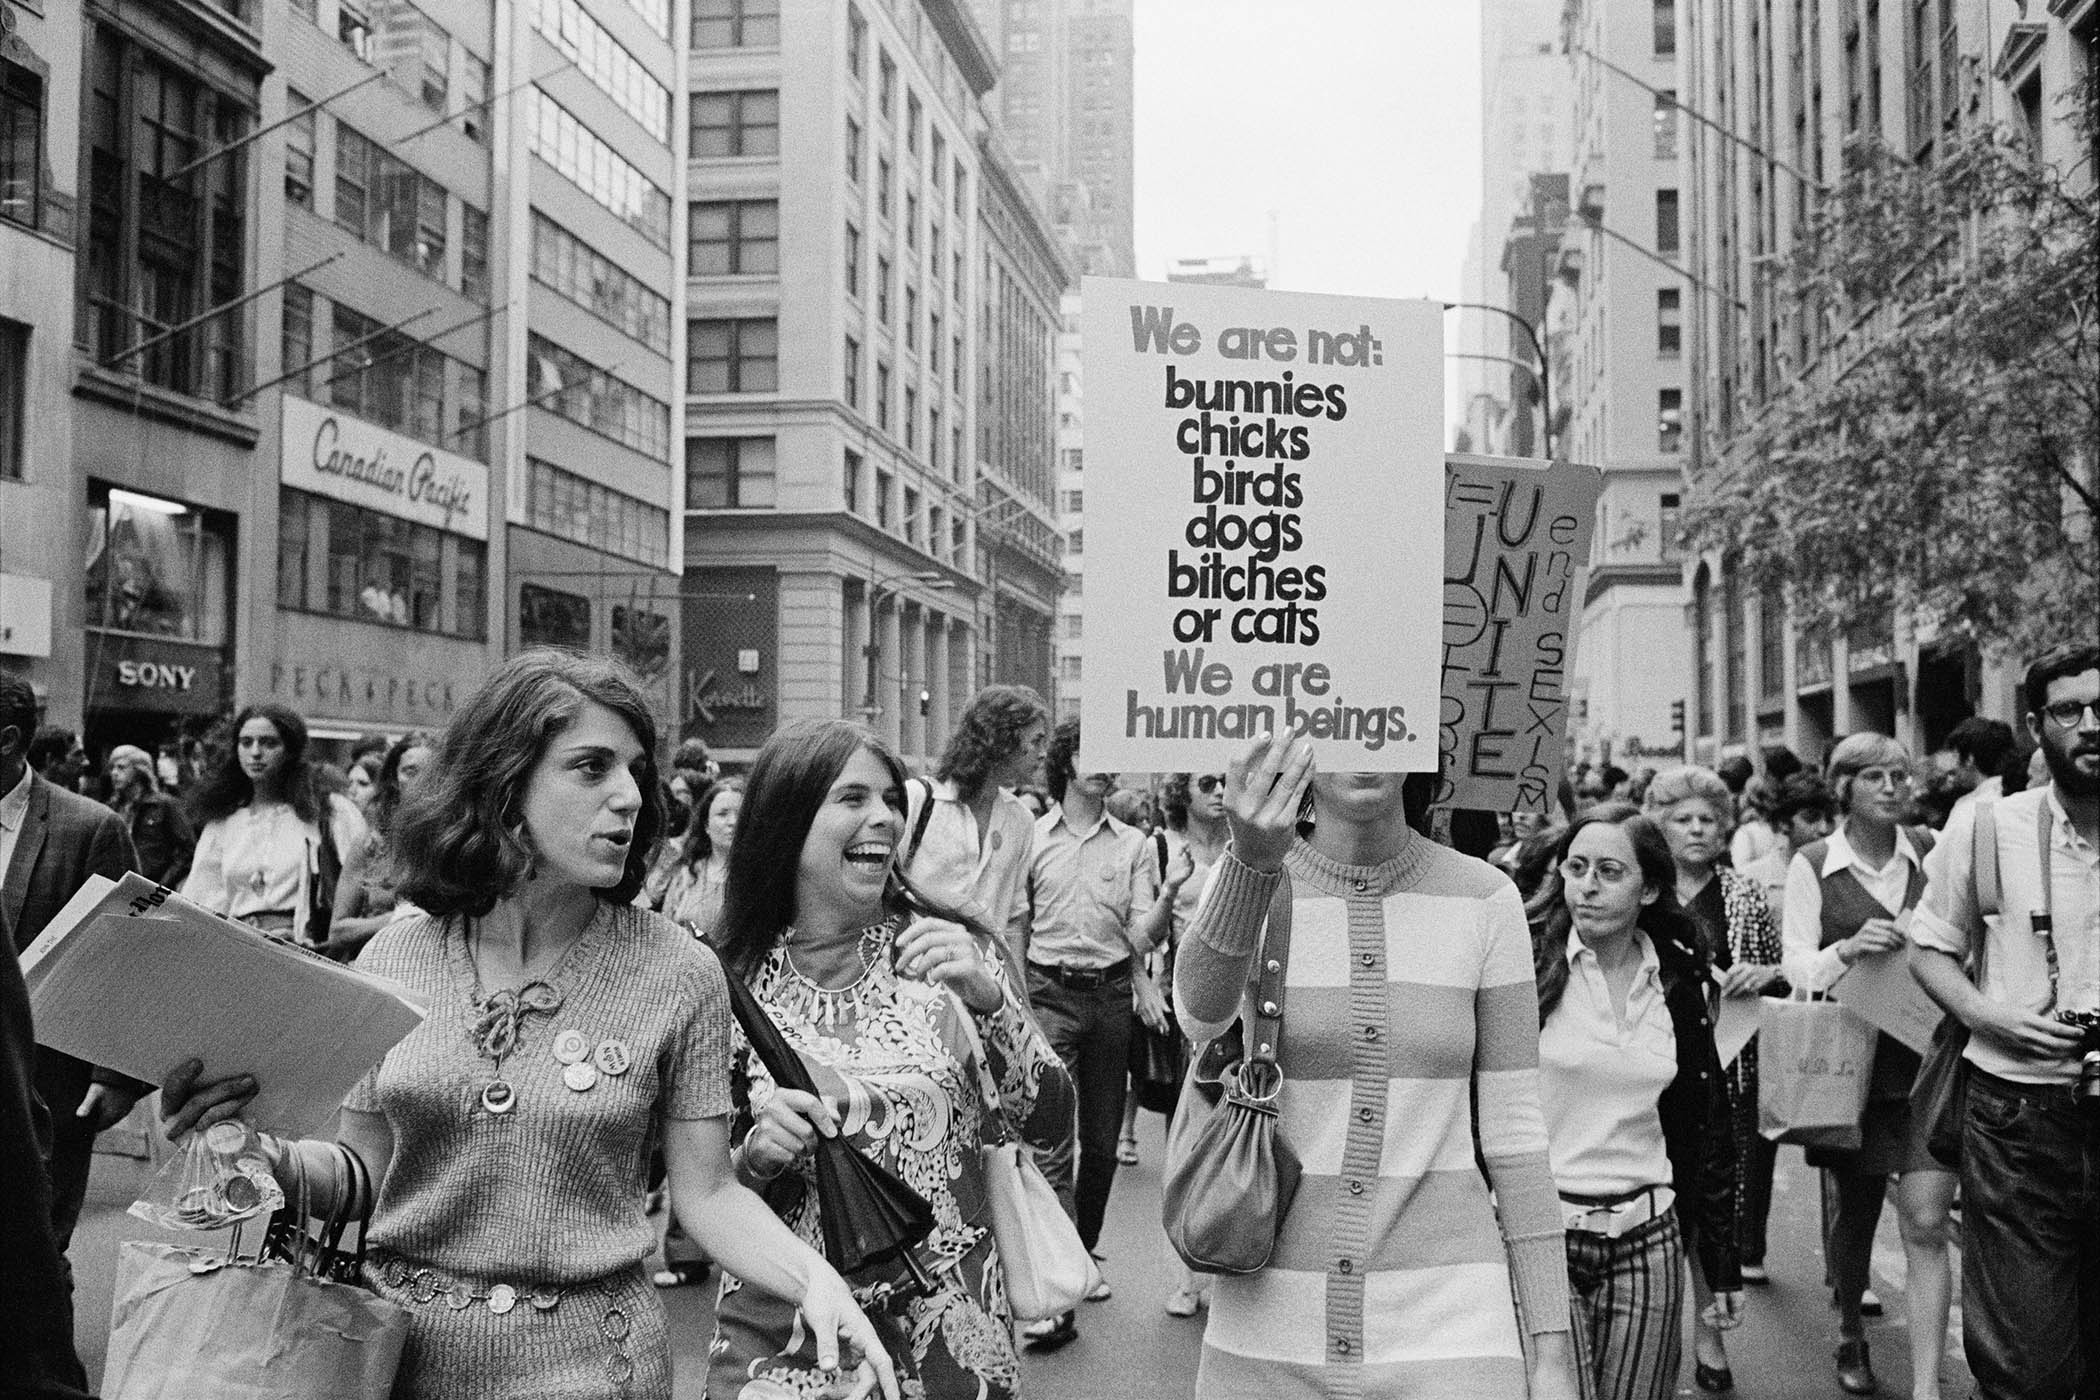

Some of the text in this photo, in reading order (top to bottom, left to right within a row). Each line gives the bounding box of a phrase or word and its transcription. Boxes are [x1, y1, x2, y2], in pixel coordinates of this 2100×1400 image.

[1130, 306, 1383, 367] We are not:
[1165, 365, 1347, 421] bunnies
[1176, 411, 1310, 461] chicks
[312, 416, 471, 528] Canadian Pacific
[1193, 456, 1304, 509] birds
[1185, 504, 1304, 562] dogs
[1168, 549, 1327, 602] bitches
[1173, 602, 1320, 647] or cats
[118, 660, 196, 690] SONY
[1163, 647, 1331, 699] We are
[1125, 689, 1418, 752] human beings.
